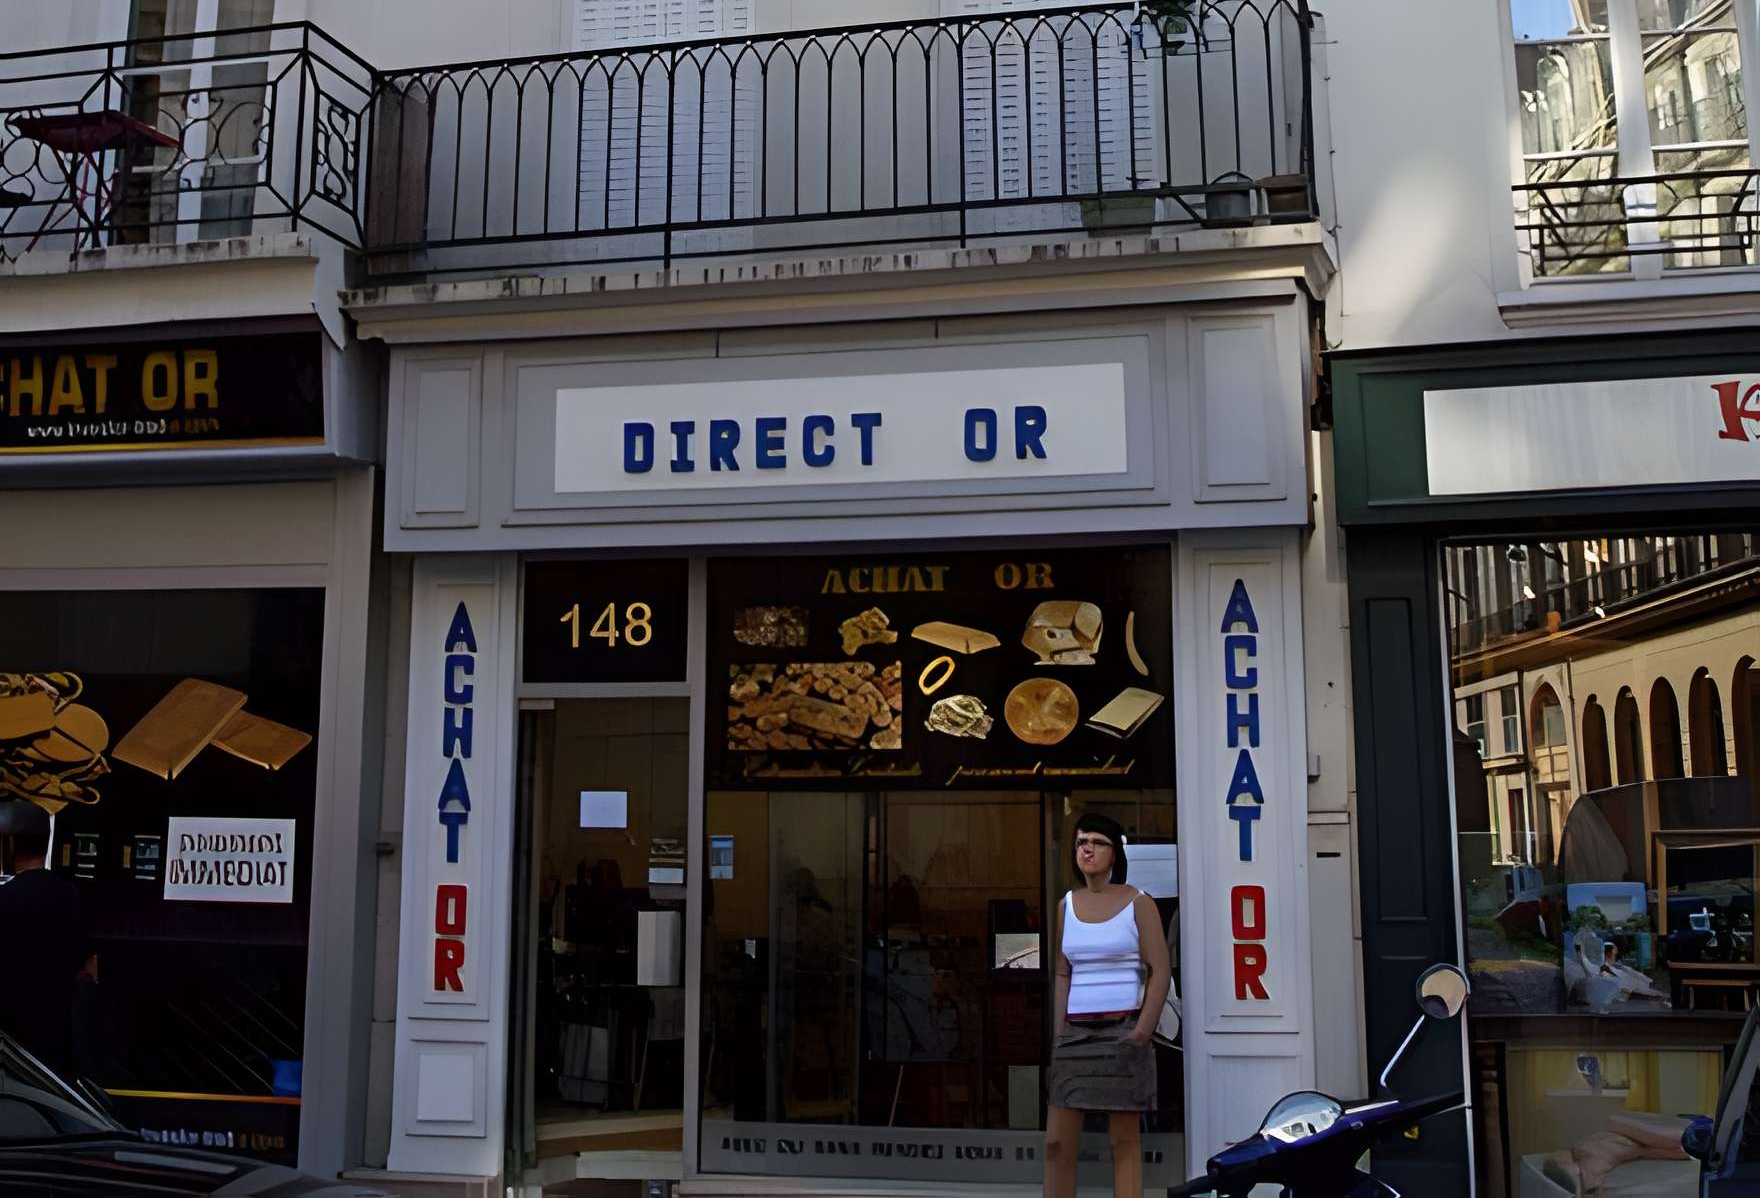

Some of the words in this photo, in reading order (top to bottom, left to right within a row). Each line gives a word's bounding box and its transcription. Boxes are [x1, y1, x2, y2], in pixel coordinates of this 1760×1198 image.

[0, 354, 118, 416] HAT
[141, 349, 219, 411] OR
[623, 411, 882, 474] DIRECT
[963, 405, 1048, 463] OR
[821, 564, 950, 594] ACHAT
[994, 562, 1055, 590] OR
[559, 602, 653, 648] 148
[437, 601, 478, 864] ACHAT
[1220, 578, 1265, 862] ACHAT
[434, 884, 469, 993] OR
[1230, 884, 1270, 1001] OR
